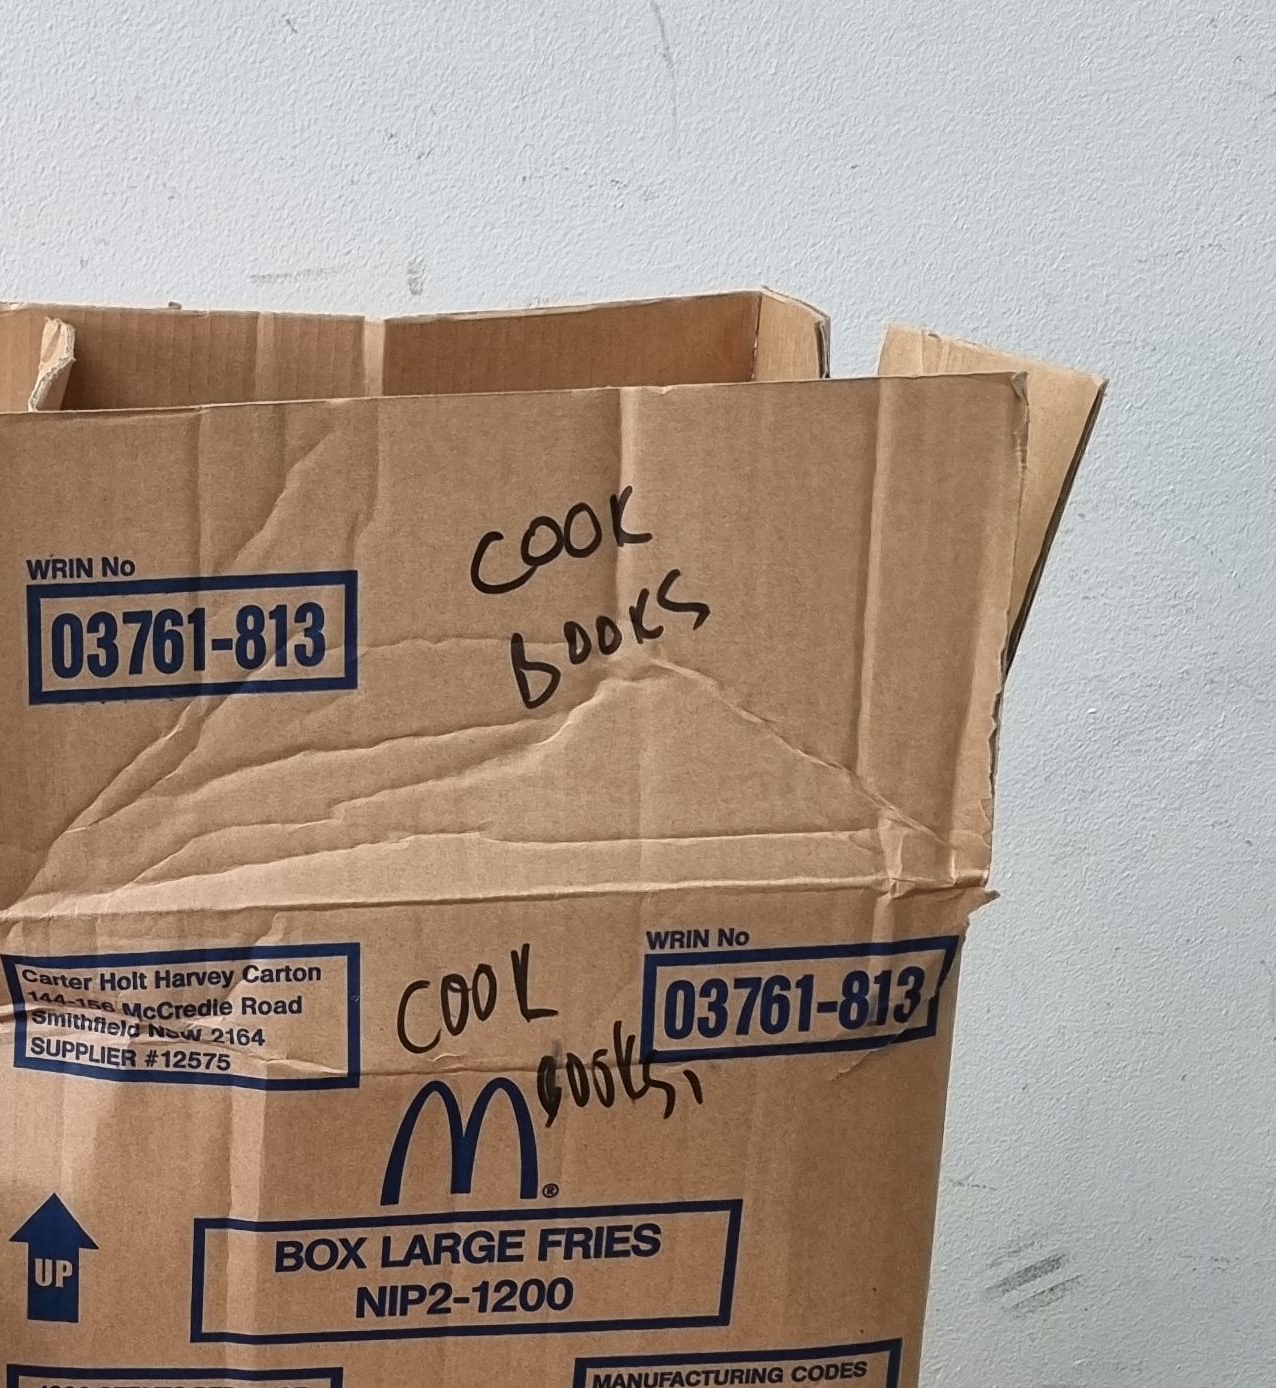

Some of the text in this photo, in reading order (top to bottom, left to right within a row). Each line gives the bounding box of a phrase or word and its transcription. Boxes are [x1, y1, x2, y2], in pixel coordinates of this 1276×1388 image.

[26, 556, 135, 580] WRIN No
[52, 602, 326, 679] 03761-813
[646, 929, 749, 950] WRIN No
[22, 963, 321, 991] Carter Holt Harvey Carton
[123, 996, 302, 1021] McCredie Road
[664, 966, 925, 1040] 03761-813
[211, 1028, 265, 1046] 2164
[31, 1038, 230, 1070] SUPPLIER #12575
[275, 1223, 661, 1273] BOX LARGE FRIES
[35, 1258, 73, 1288] UP
[355, 1277, 573, 1318] NIP2-1200
[791, 1361, 867, 1383] CODES
